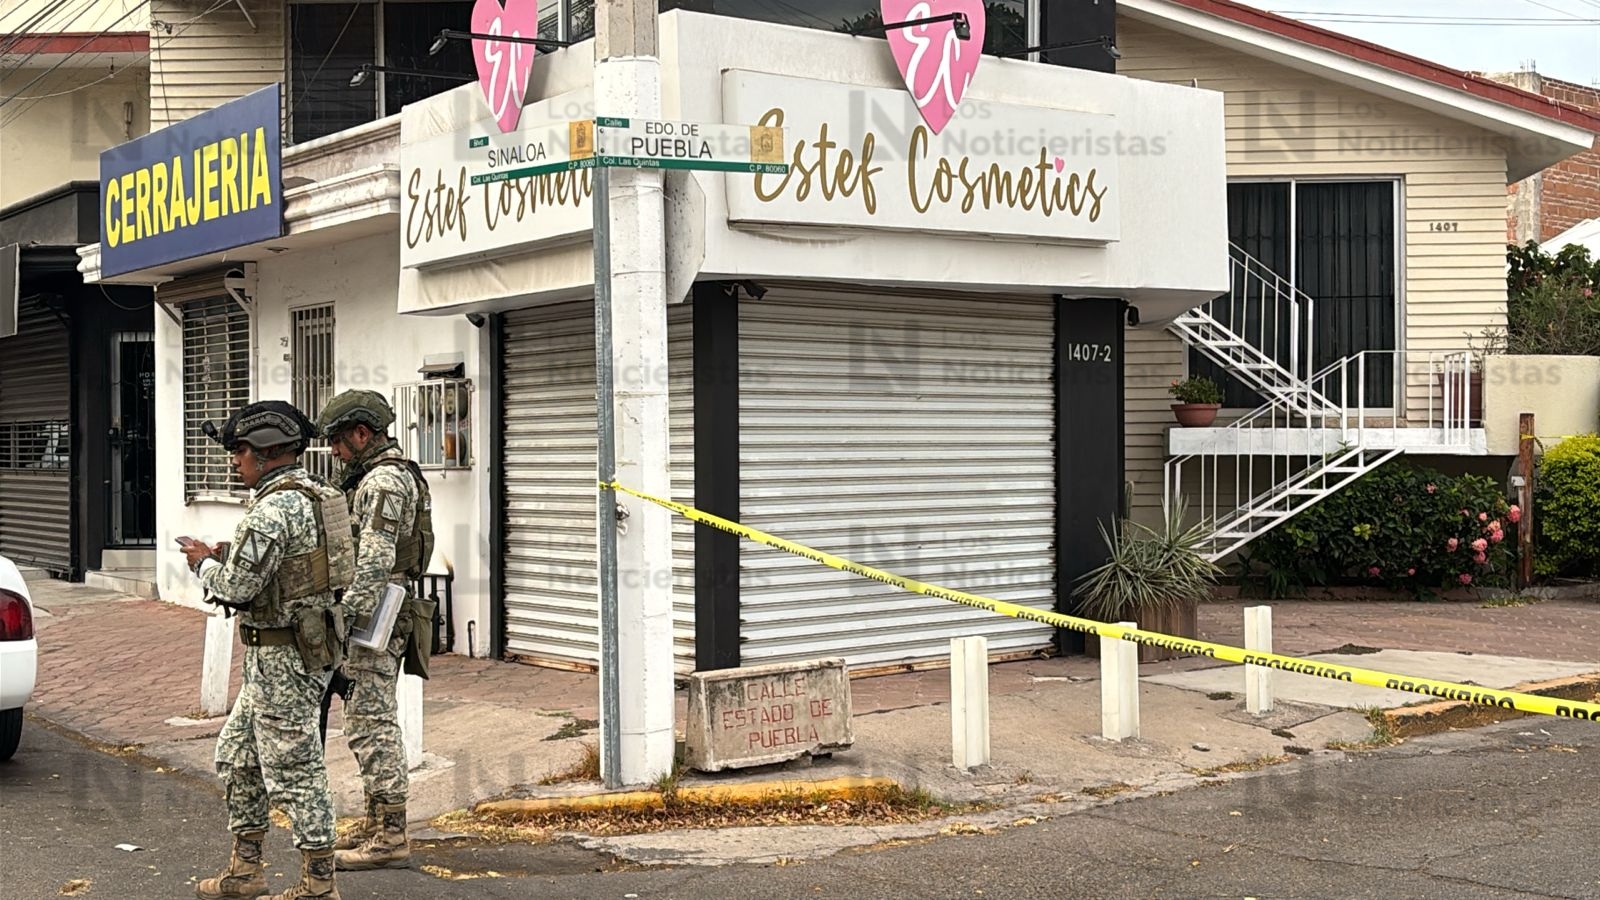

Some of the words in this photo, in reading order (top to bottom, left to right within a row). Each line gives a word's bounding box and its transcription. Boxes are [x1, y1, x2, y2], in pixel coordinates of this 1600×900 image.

[604, 118, 623, 128] Calle
[645, 122, 677, 136] EDO.
[681, 123, 699, 137] DE
[488, 142, 547, 169] SINALOA
[631, 137, 713, 159] PUEBLA
[618, 158, 632, 166] Las
[633, 159, 660, 169] Quintas
[753, 107, 883, 215] Estef
[907, 124, 1108, 223] Cosmetics
[765, 165, 786, 174] 80060
[105, 126, 272, 248] CERRAJERIA
[406, 166, 471, 249] Estef
[1429, 222, 1459, 232] 1407
[1068, 343, 1112, 362] 1407-2
[747, 677, 805, 701] CALLE
[722, 703, 794, 730] ESTADO
[809, 698, 833, 718] DE
[748, 726, 820, 750] PUEBLA
